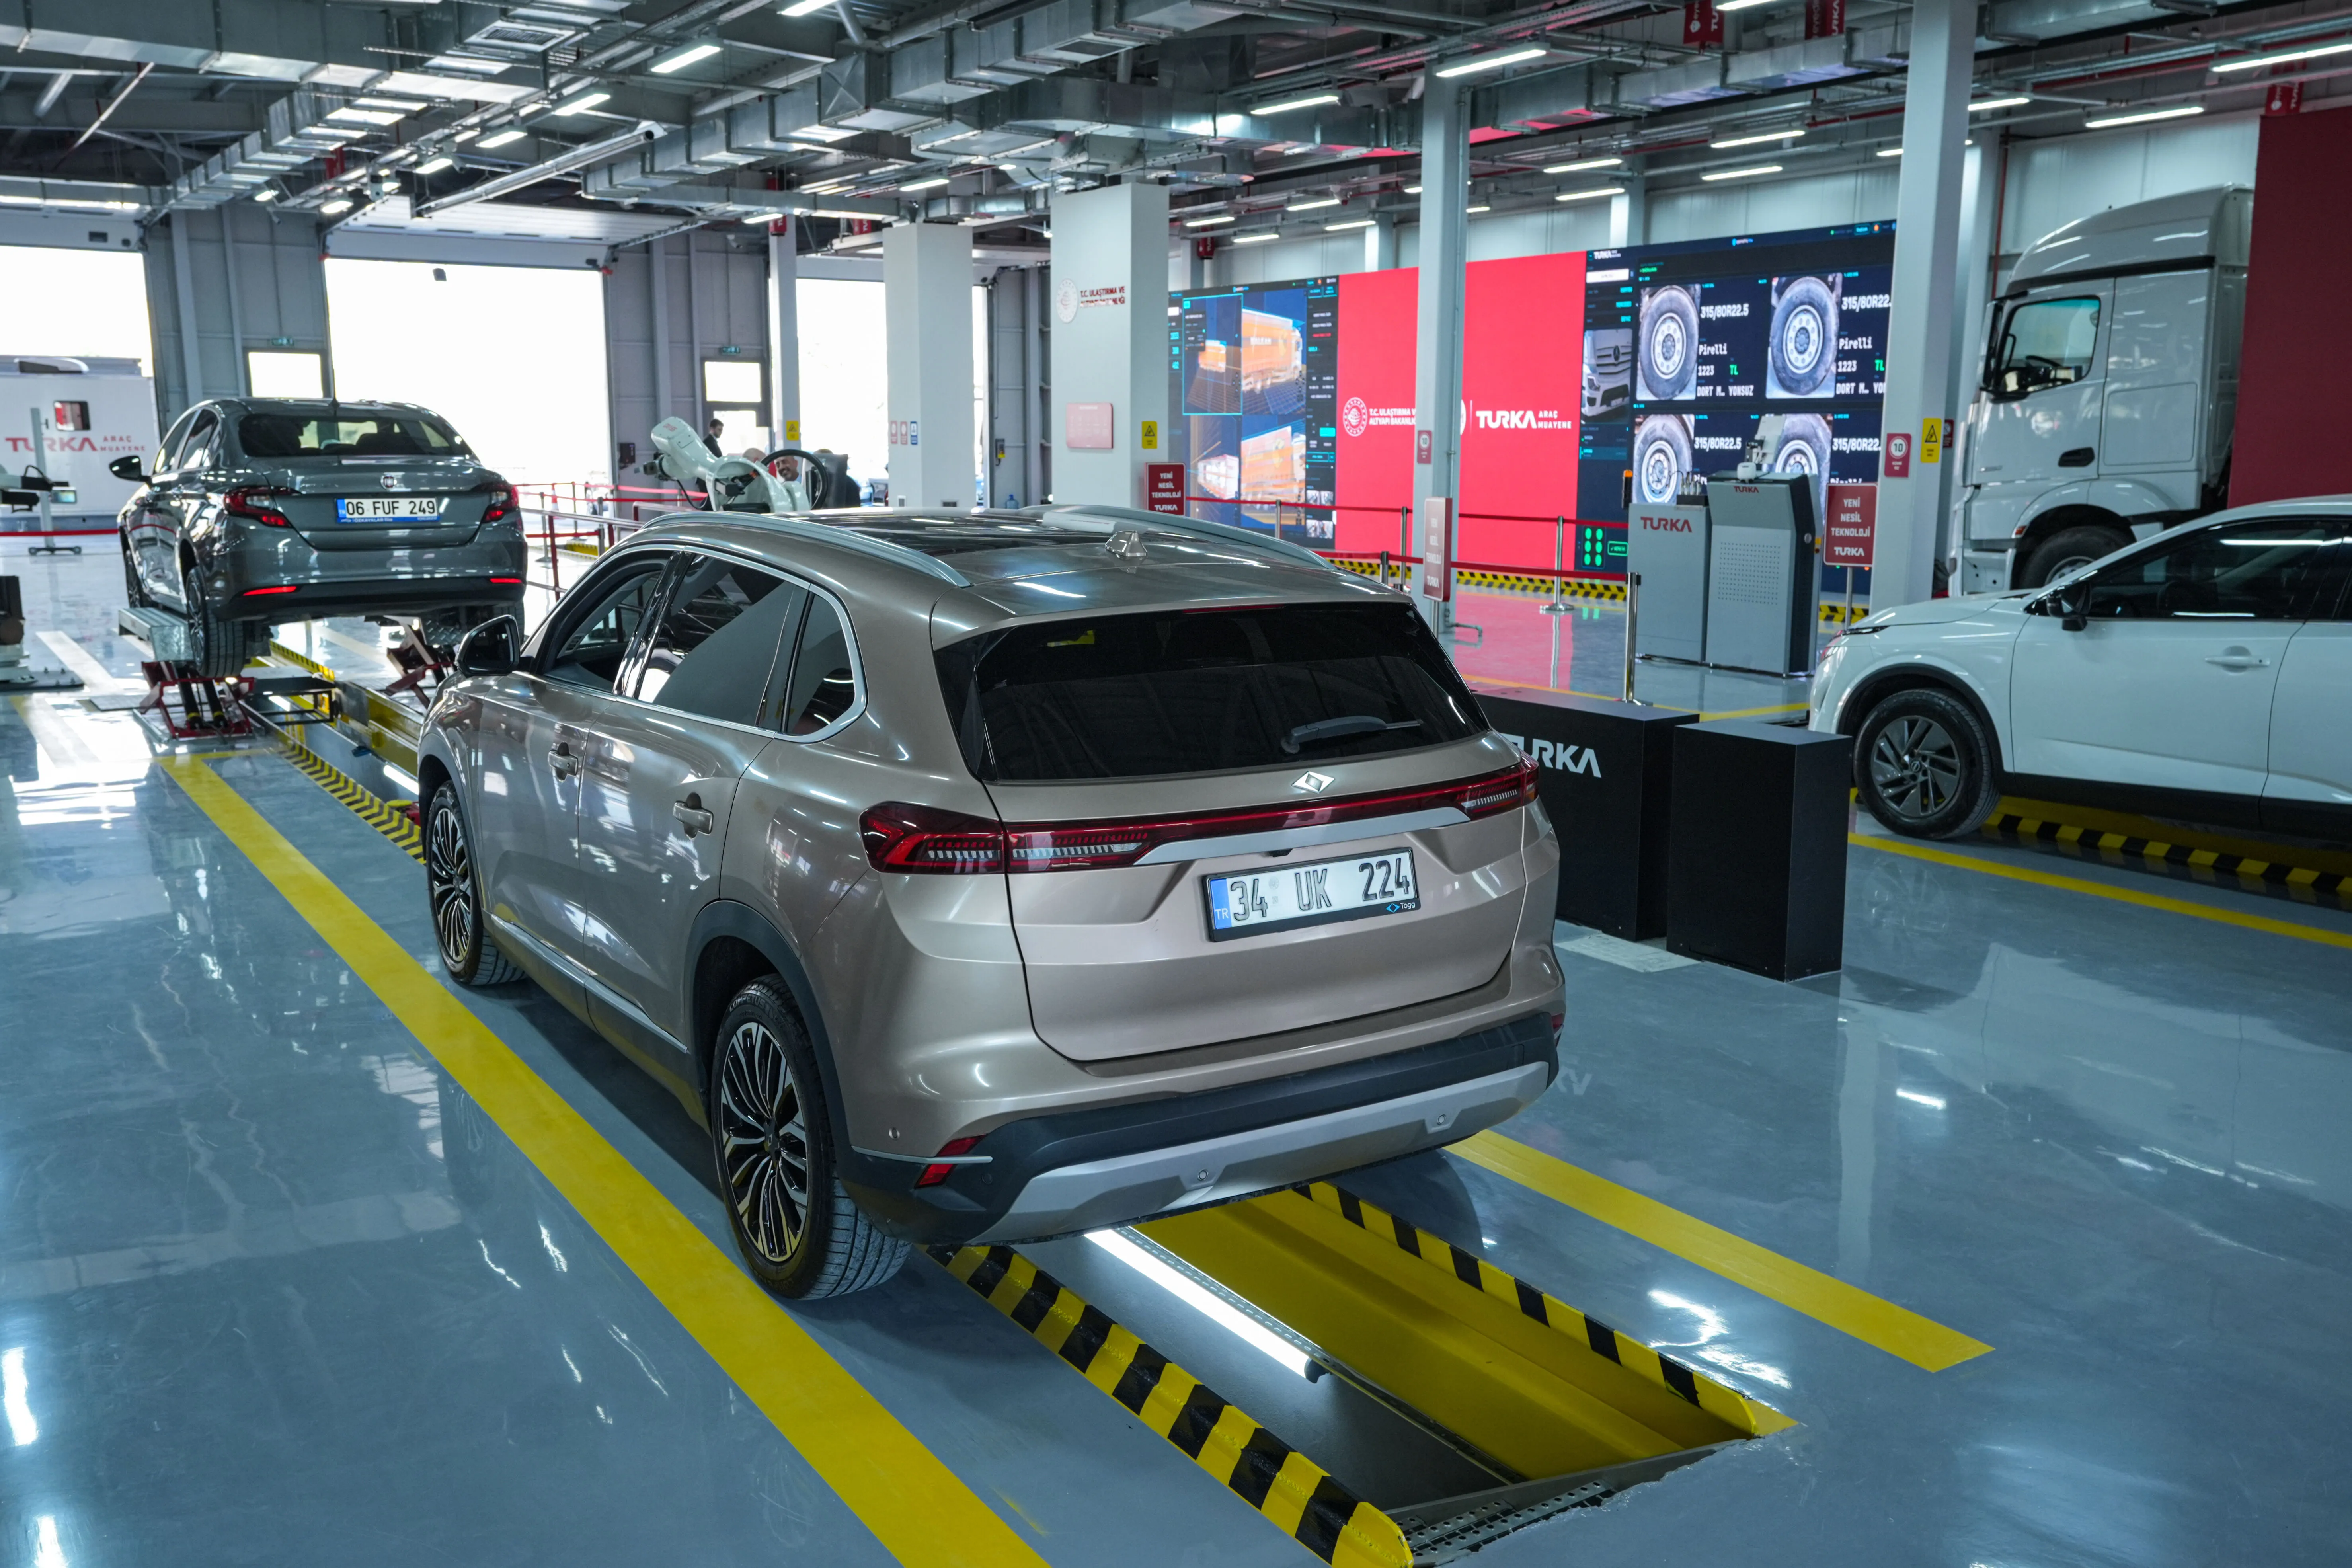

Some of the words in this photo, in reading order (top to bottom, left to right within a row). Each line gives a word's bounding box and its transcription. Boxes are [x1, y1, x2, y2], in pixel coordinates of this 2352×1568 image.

[1700, 304, 1749, 320] 315/80R22.5
[1839, 336, 1872, 349] Pirelli
[1699, 343, 1727, 355] Pirelli
[1697, 365, 1714, 376] 1223
[1730, 364, 1738, 375] TL
[1837, 360, 1857, 372] 1223
[1874, 359, 1885, 371] TL
[1379, 408, 1411, 417] ULAŞTIRMA
[1539, 410, 1558, 419] ARAÇ
[1476, 410, 1537, 429] TURKA
[1537, 420, 1572, 429] MUAYENE
[1694, 437, 1742, 452] 315/80R22.5
[1894, 443, 1903, 452] 10
[346, 501, 365, 515] 06
[372, 501, 399, 515] FUF
[408, 501, 435, 515] 249
[1843, 497, 1860, 507] YENİ
[1841, 511, 1861, 523] NESİL
[1640, 516, 1692, 532] TURKA
[1831, 526, 1870, 537] TEKNOLOJİ
[1834, 547, 1864, 556] TURKA
[1230, 878, 1268, 921] 34
[1295, 868, 1332, 911] UK
[1359, 858, 1410, 901] 224
[1400, 901, 1416, 910] Togg
[1215, 908, 1229, 920] TR
[729, 995, 765, 1013] COMPETUS
